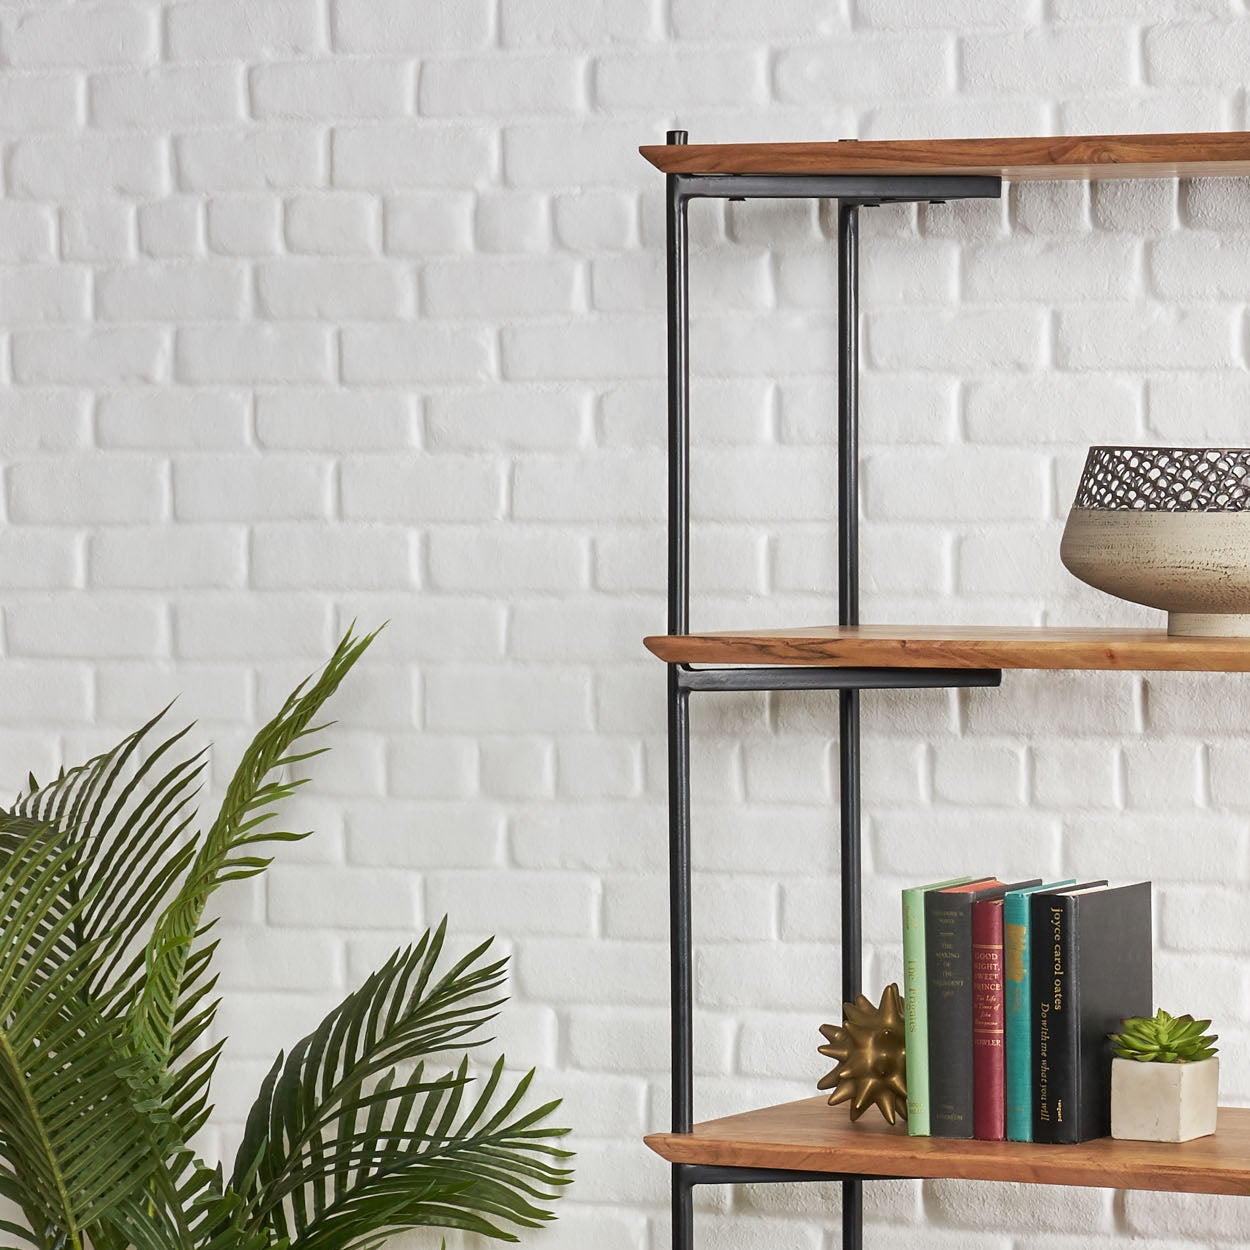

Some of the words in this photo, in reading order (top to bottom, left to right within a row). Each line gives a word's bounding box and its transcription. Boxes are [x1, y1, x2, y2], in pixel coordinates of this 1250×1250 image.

[1051, 907, 1064, 941] joyce
[974, 951, 999, 961] GOOD
[1053, 944, 1064, 976] carol
[1054, 979, 1063, 1011] oates
[1041, 1002, 1050, 1018] Do
[1040, 1019, 1050, 1042] with
[1040, 1043, 1048, 1057] me
[1040, 1059, 1050, 1083] what
[1038, 1083, 1048, 1101] you
[1040, 1102, 1050, 1121] will
